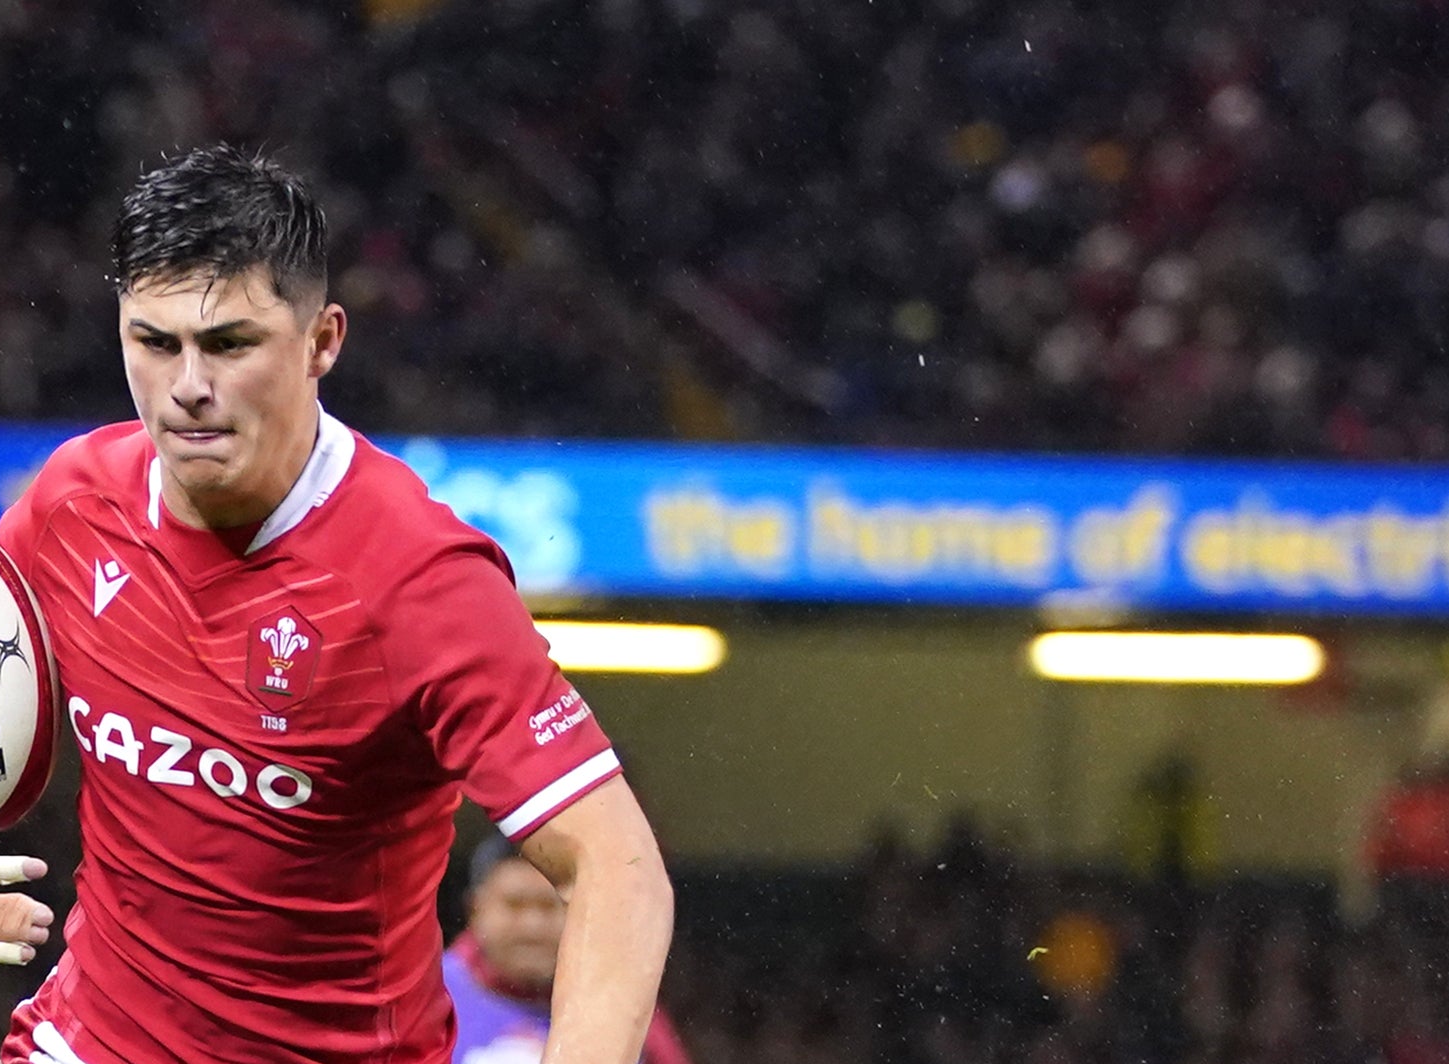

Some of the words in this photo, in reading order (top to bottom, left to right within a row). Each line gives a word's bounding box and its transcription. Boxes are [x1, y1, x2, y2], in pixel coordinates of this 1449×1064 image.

[647, 474, 793, 580] the
[808, 476, 1057, 585] home
[1069, 483, 1177, 588] of
[265, 675, 289, 690] WRU
[68, 696, 313, 809] CAZOO
